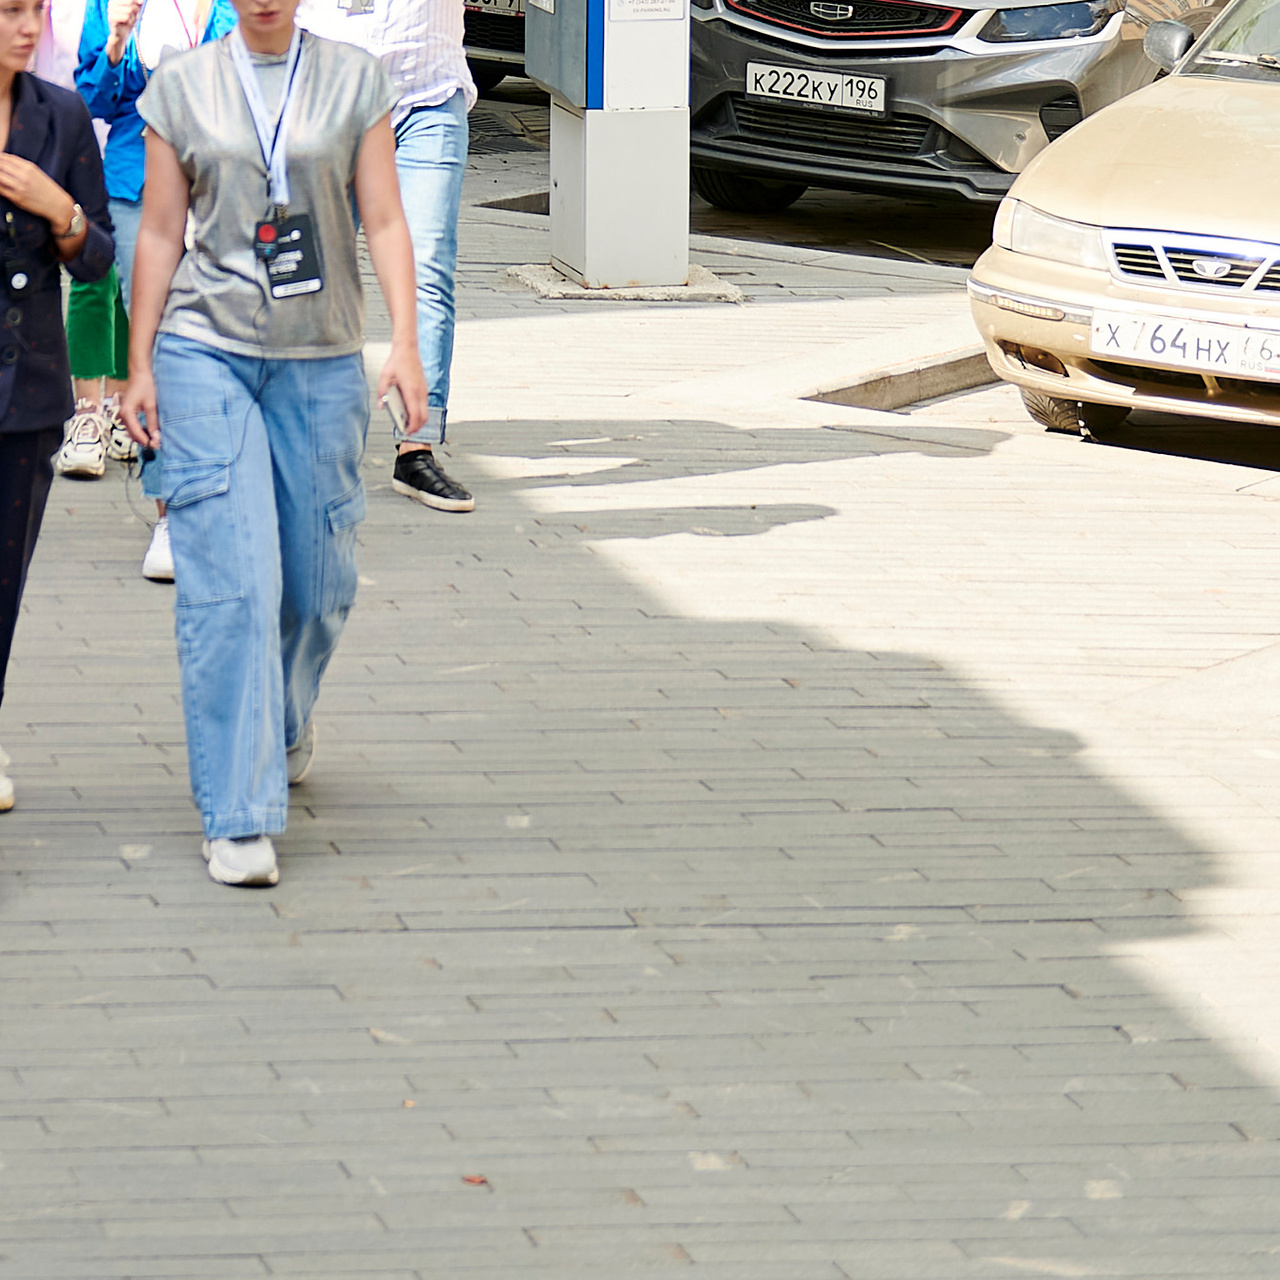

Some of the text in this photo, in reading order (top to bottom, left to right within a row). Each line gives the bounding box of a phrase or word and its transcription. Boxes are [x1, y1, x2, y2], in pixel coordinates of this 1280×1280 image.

[754, 69, 878, 101] К222КУ 196
[855, 98, 873, 108] RUS
[1240, 360, 1263, 371] RUS
